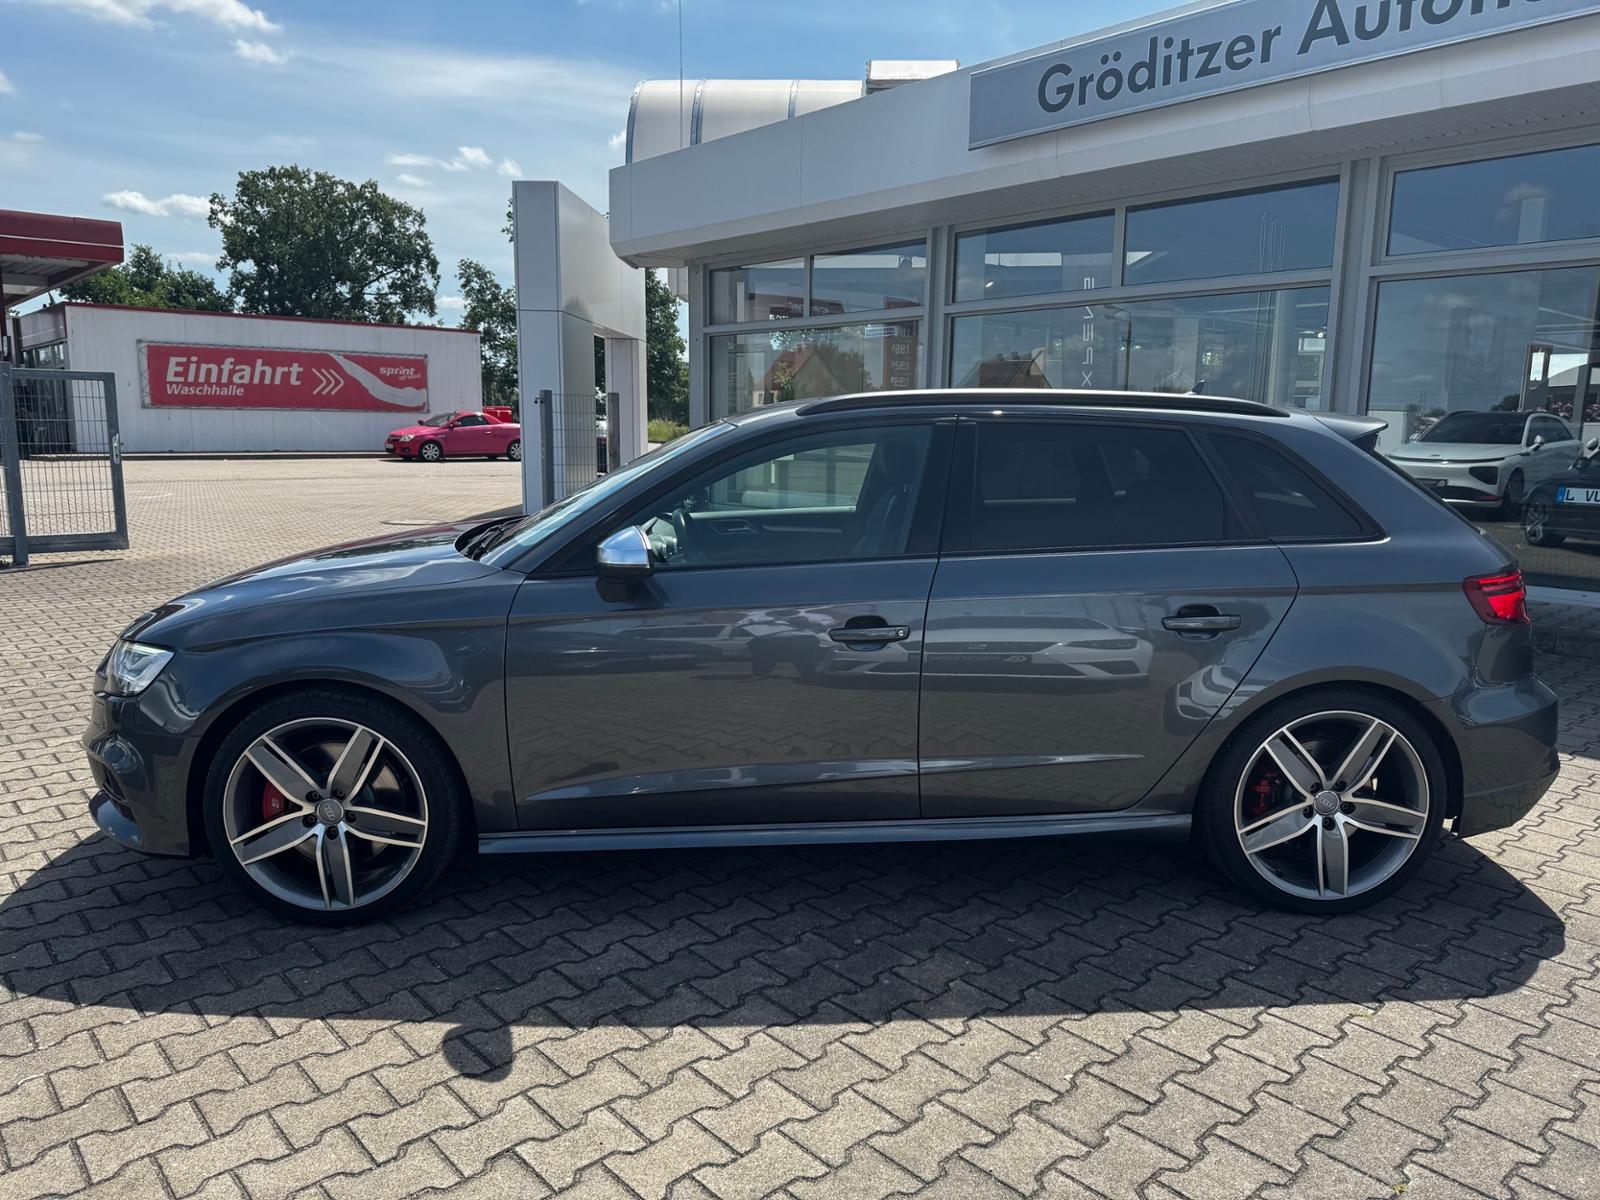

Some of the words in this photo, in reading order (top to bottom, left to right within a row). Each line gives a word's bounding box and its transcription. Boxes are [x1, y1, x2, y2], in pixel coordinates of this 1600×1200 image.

[1037, 25, 1282, 113] Gröditzer
[1297, 0, 1547, 55] Auto
[166, 356, 304, 386] Einfahrt
[379, 366, 416, 376] sprint
[166, 383, 245, 396] Waschhalle
[1565, 489, 1575, 501] L
